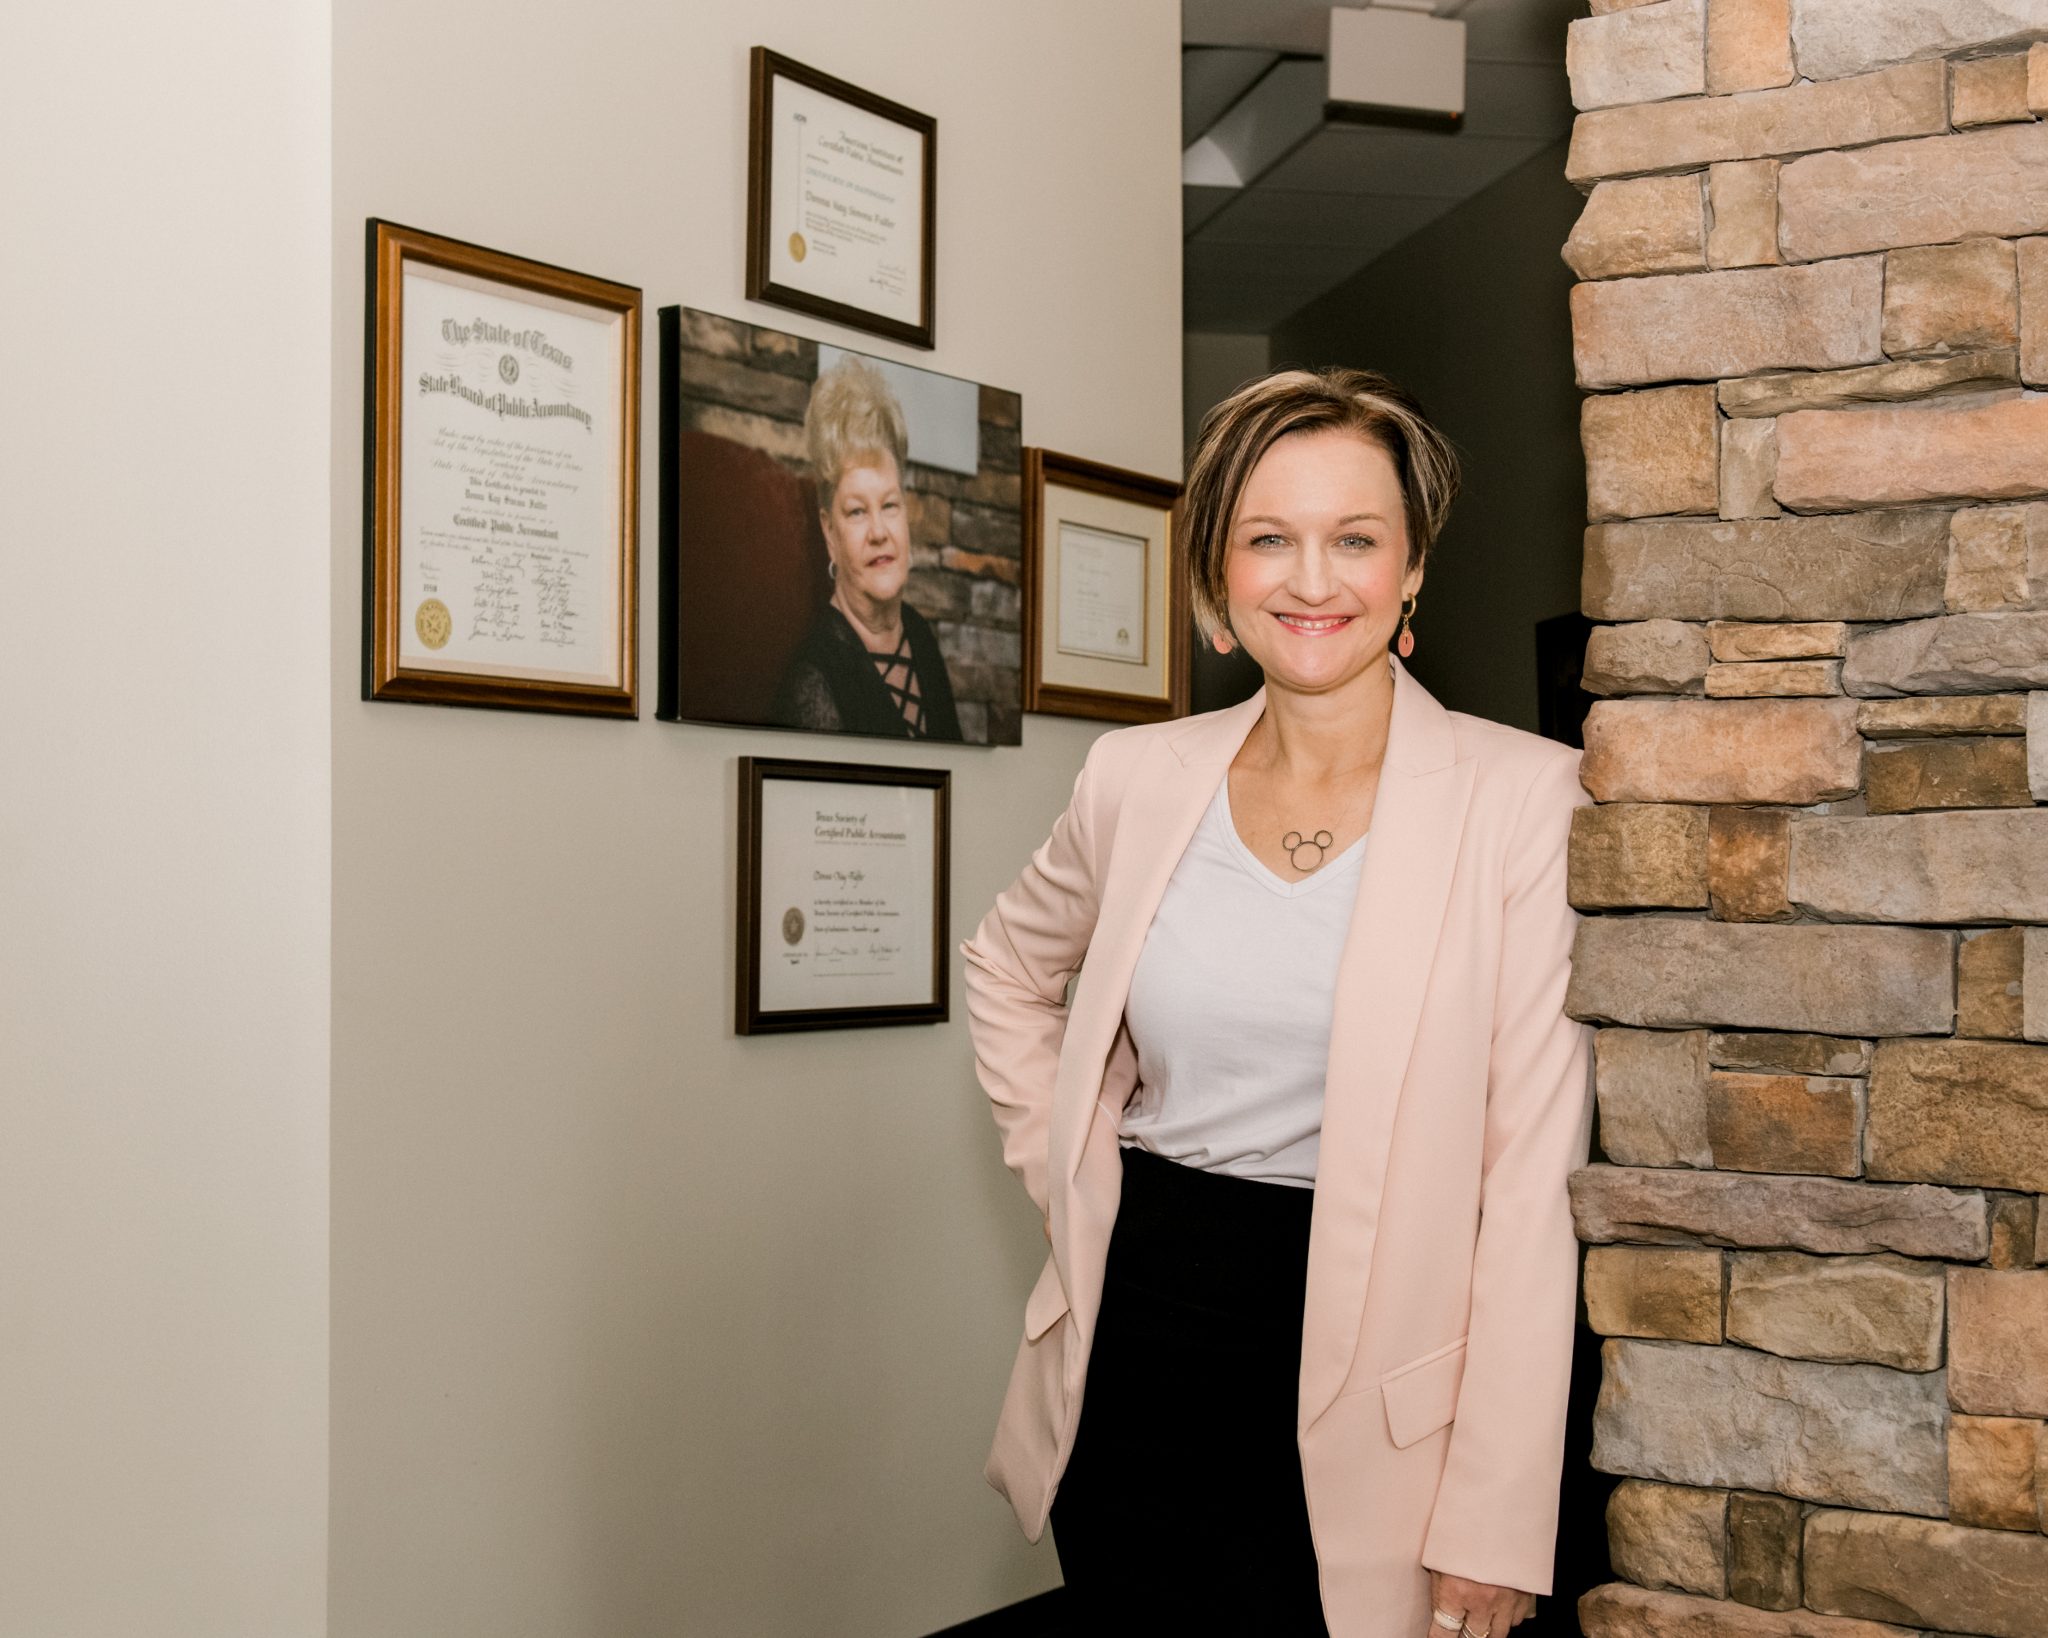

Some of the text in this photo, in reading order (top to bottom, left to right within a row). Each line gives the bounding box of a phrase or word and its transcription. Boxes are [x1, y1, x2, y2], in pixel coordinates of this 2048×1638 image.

[441, 316, 573, 370] The State of Texas
[418, 372, 592, 431] State Board of Public Accountancy
